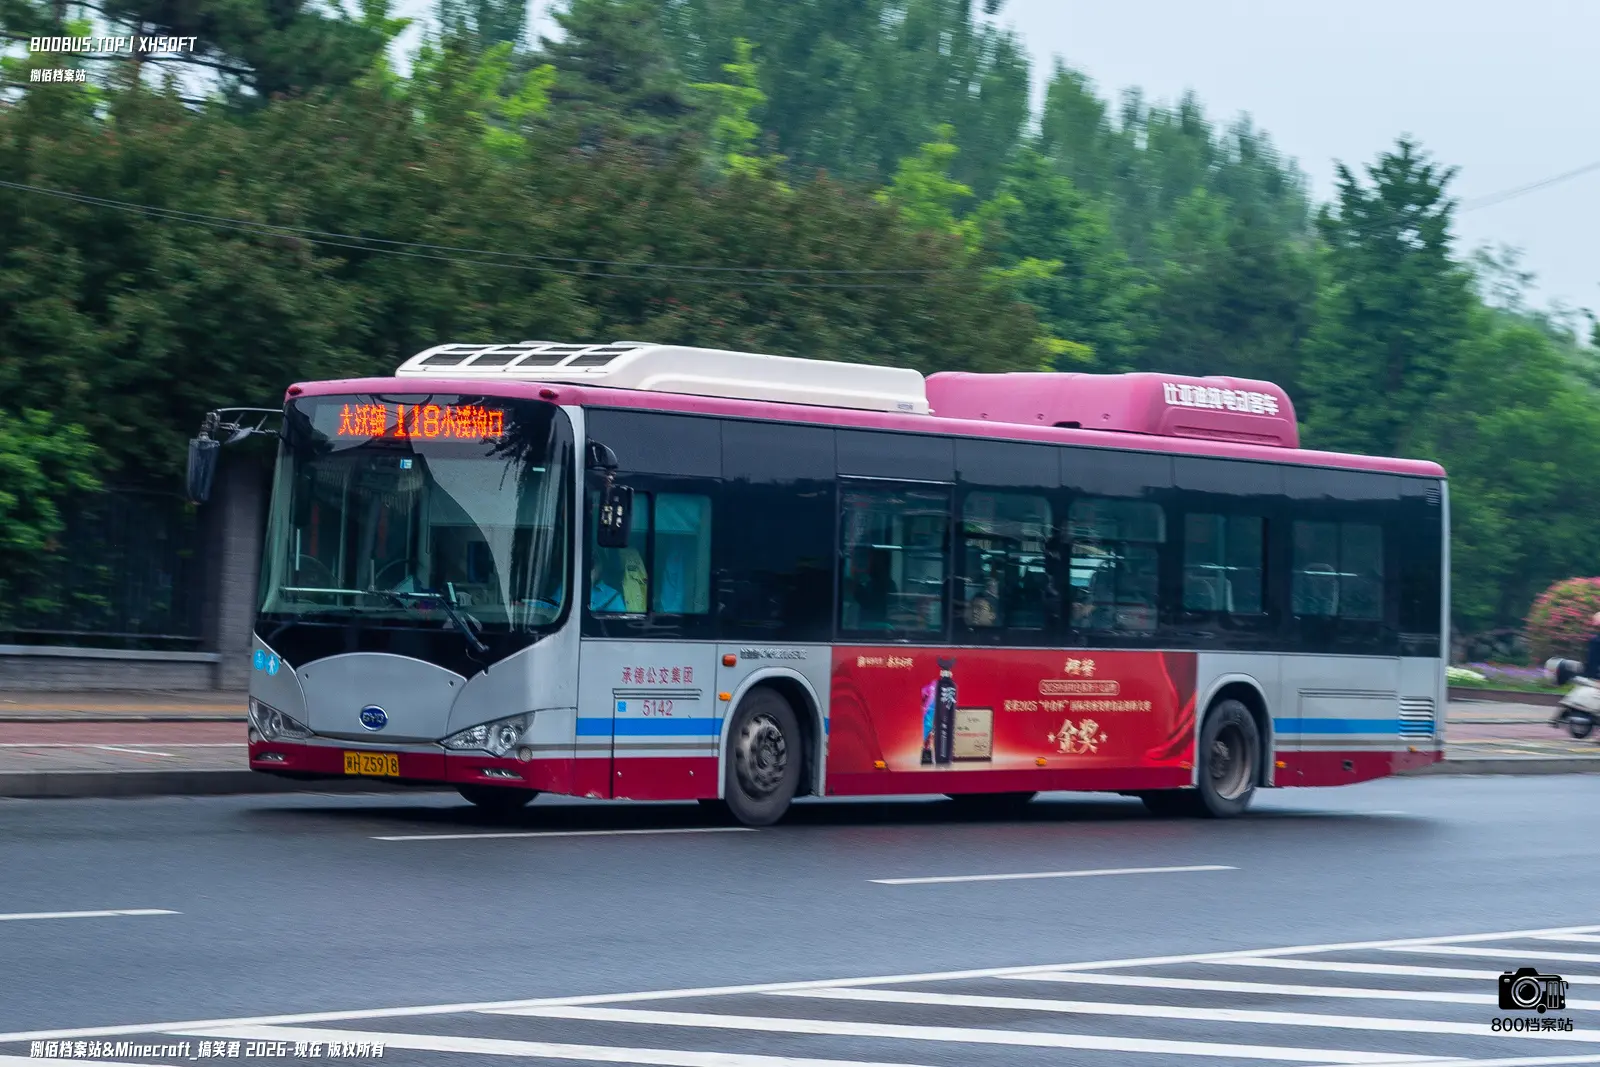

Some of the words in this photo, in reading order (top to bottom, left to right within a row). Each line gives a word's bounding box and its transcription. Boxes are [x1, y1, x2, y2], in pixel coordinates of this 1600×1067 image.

[1162, 381, 1280, 416] 比亚迪纯电动客车
[393, 404, 440, 438] 118
[621, 666, 694, 685] 承德公交集团
[361, 711, 385, 724] BYD
[641, 699, 674, 717] 5142
[1055, 717, 1100, 755] 金奖
